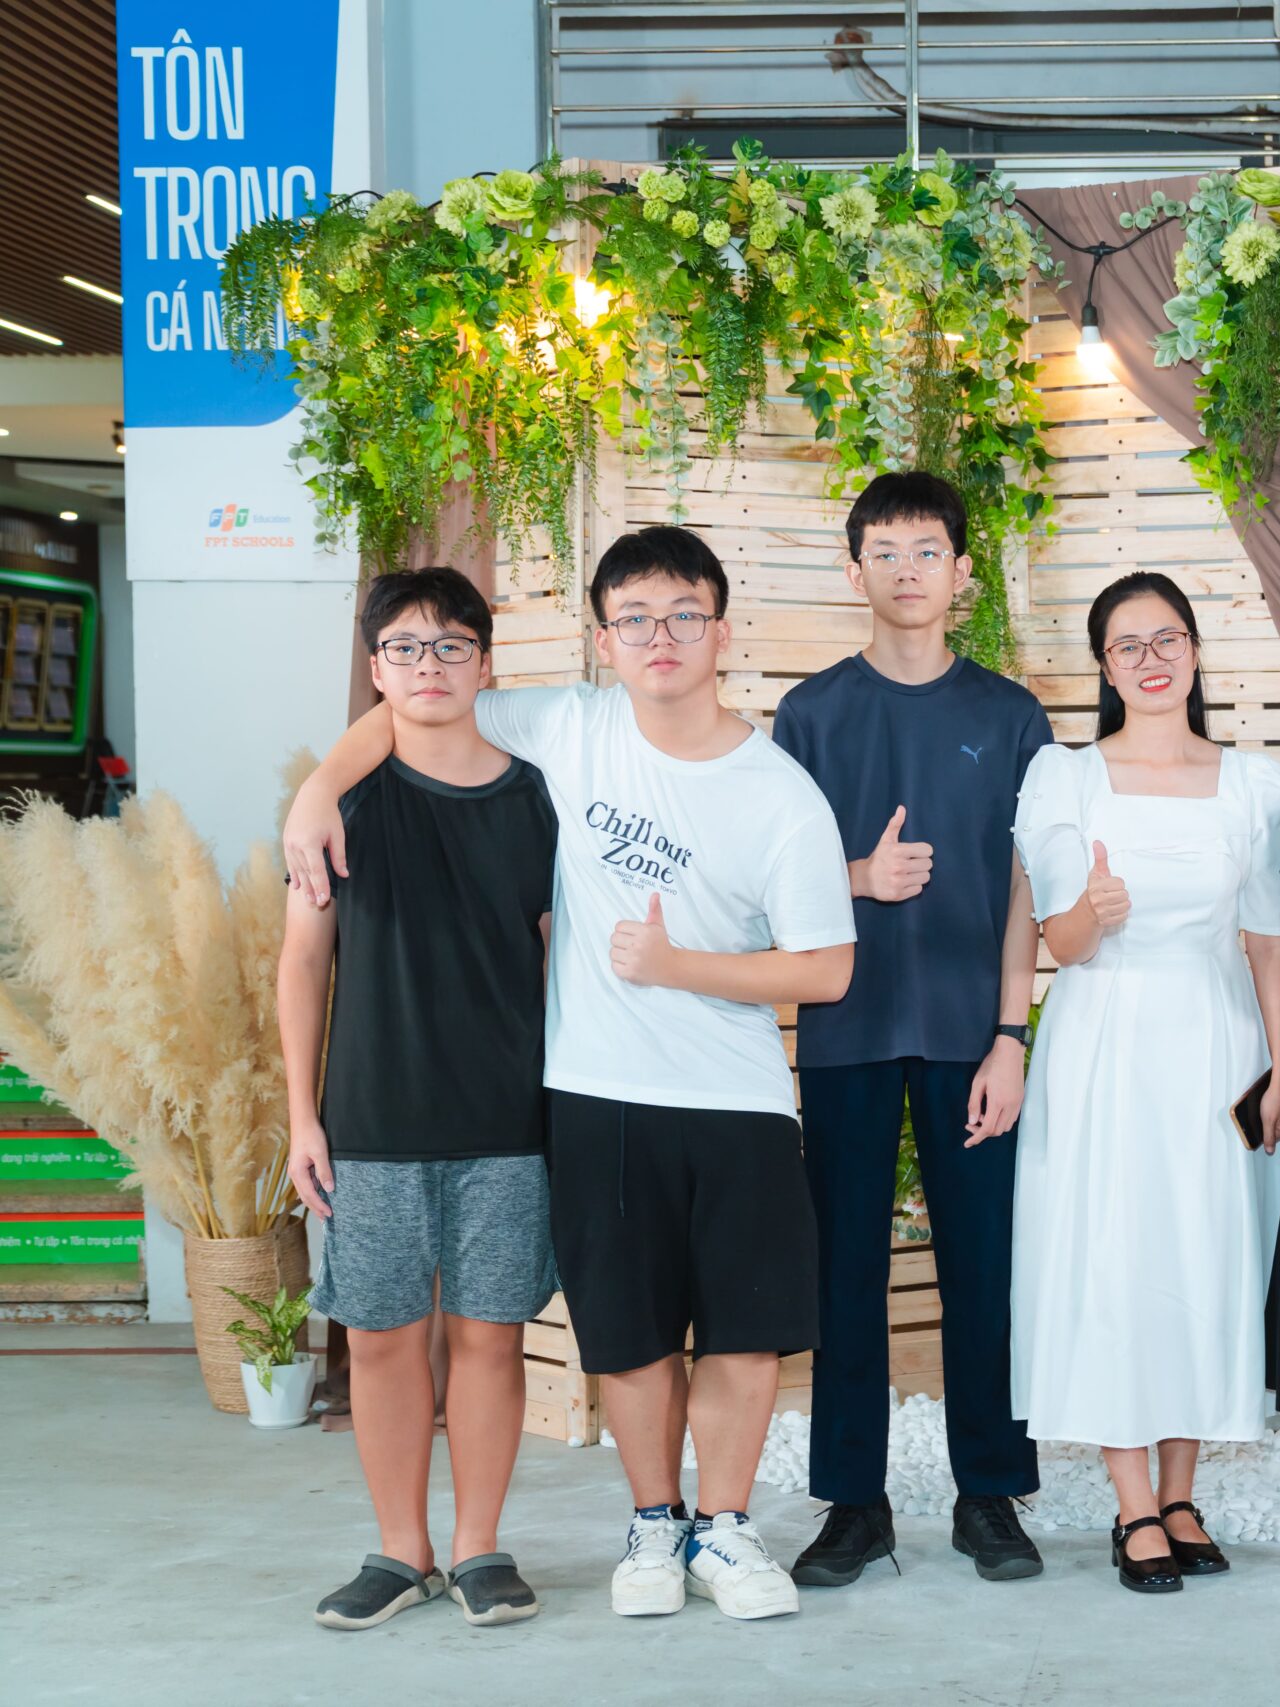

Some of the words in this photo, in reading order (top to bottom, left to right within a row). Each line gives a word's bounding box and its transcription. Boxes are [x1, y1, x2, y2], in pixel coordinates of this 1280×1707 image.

[131, 29, 245, 141] TÔN
[146, 279, 193, 352] CÁ
[205, 535, 228, 547] FPT
[231, 535, 295, 547] SCHOOLS
[208, 503, 249, 532] FPT
[586, 801, 653, 845] Chill
[654, 835, 692, 868] out
[601, 837, 675, 884] Zone
[611, 868, 635, 880] LONDON
[660, 885, 677, 895] TOKYO
